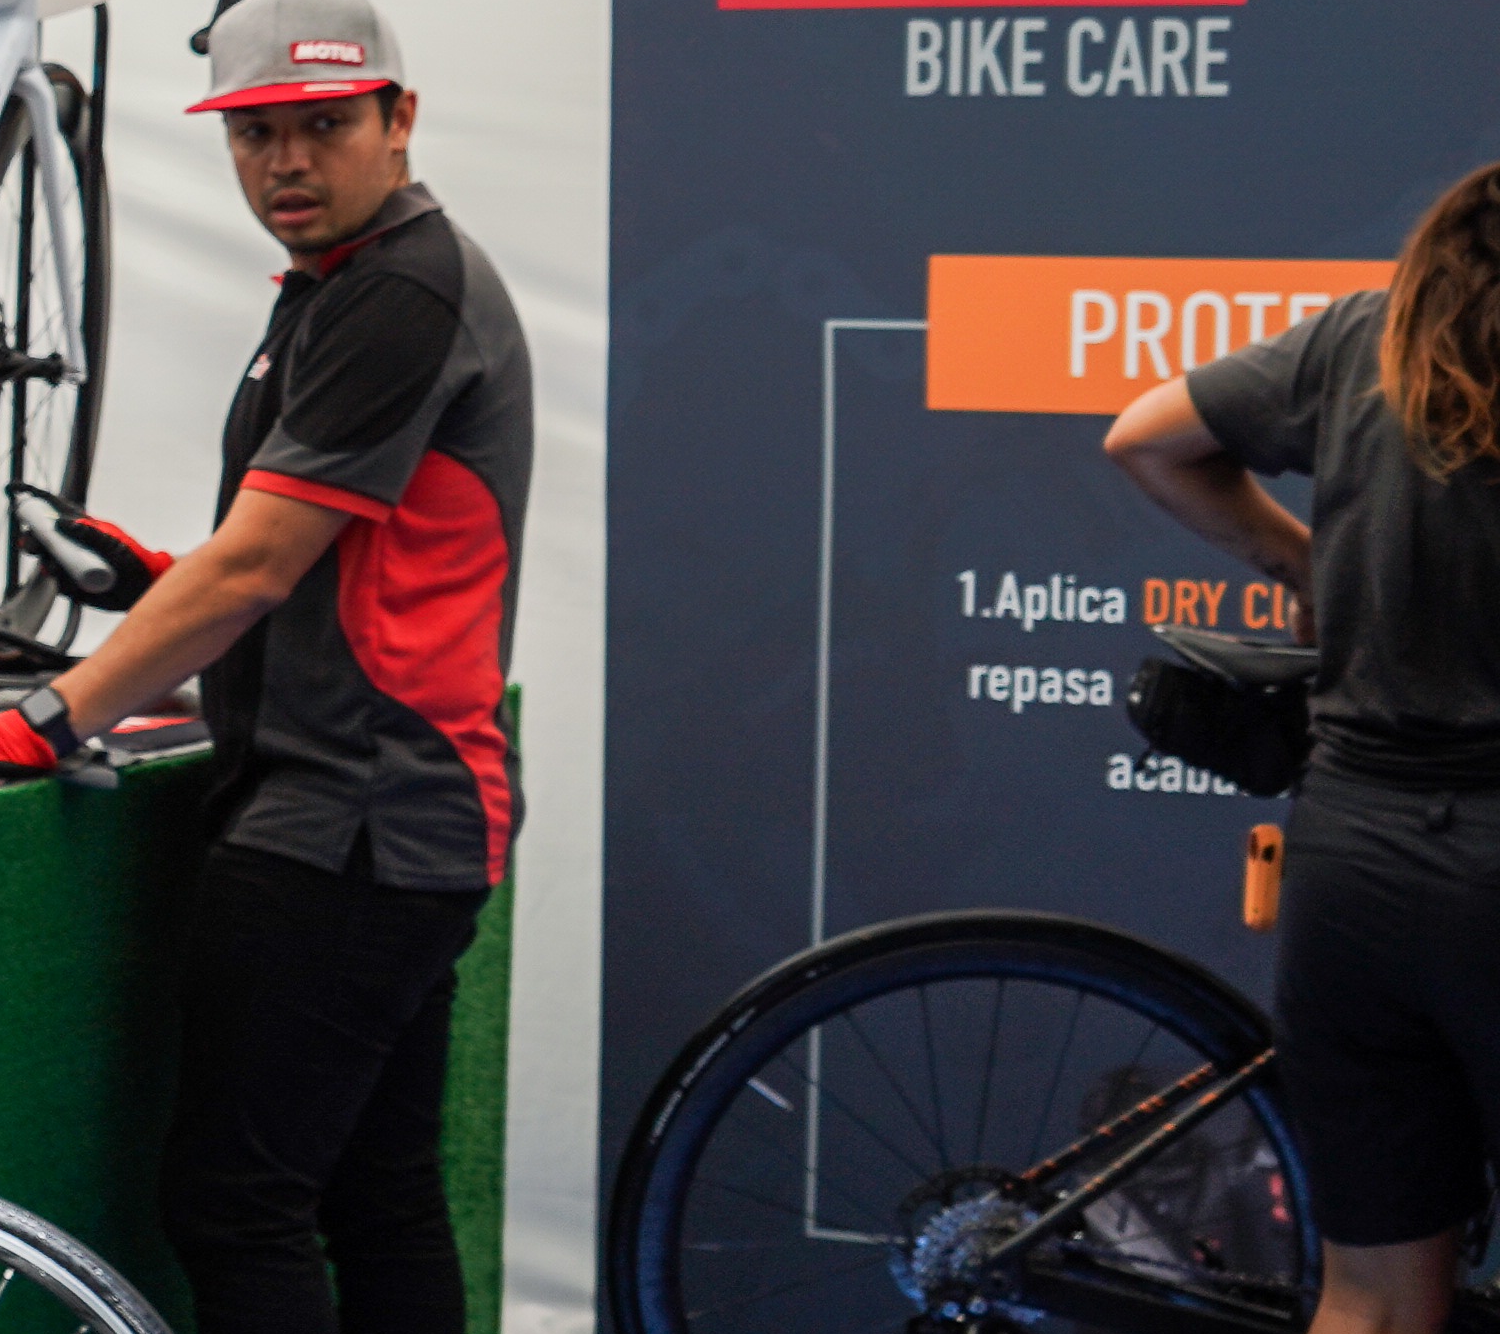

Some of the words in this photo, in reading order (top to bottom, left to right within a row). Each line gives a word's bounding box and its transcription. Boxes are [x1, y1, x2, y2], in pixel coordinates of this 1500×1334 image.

[294, 43, 361, 61] MOTUL
[906, 19, 1046, 97] BIKE
[1067, 18, 1231, 97] CARE
[1143, 578, 1227, 629] DRY
[969, 659, 1114, 713] repasa
